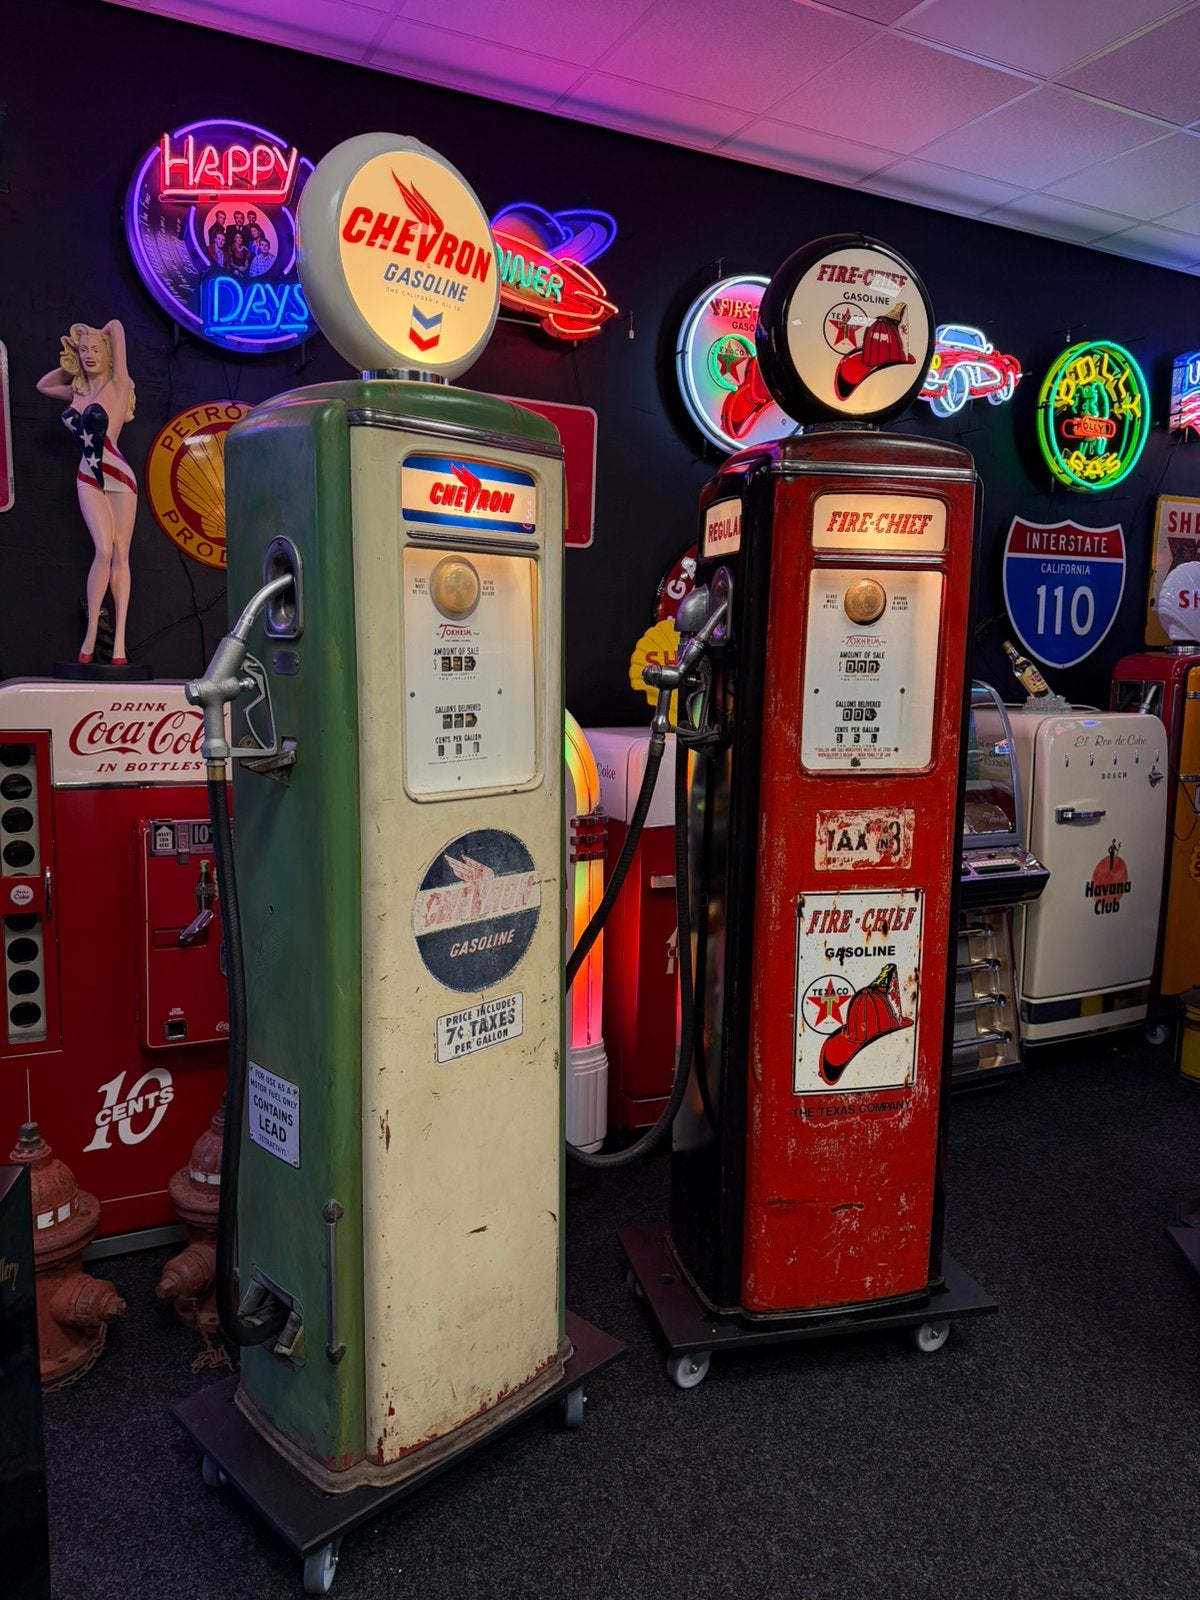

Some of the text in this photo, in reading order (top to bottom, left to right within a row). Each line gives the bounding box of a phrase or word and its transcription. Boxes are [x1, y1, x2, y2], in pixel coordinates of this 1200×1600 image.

[160, 133, 298, 192] HAPPY
[342, 206, 493, 283] CHEVRON
[384, 262, 469, 303] GASOLINE
[212, 276, 309, 323] DAYS
[843, 291, 890, 306] GASOLINE
[717, 346, 745, 357] EXACO
[161, 405, 251, 453] PETRO
[1070, 450, 1121, 477] GAS
[429, 481, 515, 514] CHEVRON
[826, 511, 934, 535] FIRE-CHIEF
[1026, 532, 1108, 554] INTERSTATE
[1040, 562, 1091, 575] CALIFORNIA
[1036, 584, 1095, 636] 110
[433, 646, 480, 656] AMOUNT OF SALE
[839, 651, 885, 659] AMOUNT OF SALE
[110, 702, 168, 712] DRINK
[435, 703, 481, 714] GALLONS DELIVERED
[835, 700, 881, 708] GALLONS DELIVERED
[69, 710, 206, 757] Coca-Col
[435, 733, 482, 744] CENTS PER GALLON
[97, 761, 203, 772] IN BOTTLES
[1101, 771, 1128, 780] BOSCH
[825, 829, 868, 852] TAX
[1084, 880, 1132, 898] Havana
[1094, 899, 1120, 915] Club
[450, 928, 516, 958] GASOLINE
[825, 945, 896, 959] GASOLINE
[812, 987, 849, 996] TEXACO
[446, 996, 516, 1027] PRICE INCLUDES
[446, 1007, 516, 1046] 7¢ TAXES
[454, 1028, 509, 1055] PER GALLON
[250, 1078, 297, 1110] MOTOR FUEL ONLY
[254, 1069, 291, 1095] FOR USE AS A
[83, 1067, 174, 1153] 10
[95, 1085, 174, 1127] CENTS
[253, 1094, 293, 1127] CONTAINS
[792, 1099, 912, 1119] THE TEXAS COMPANY
[259, 1113, 287, 1143] LEAD
